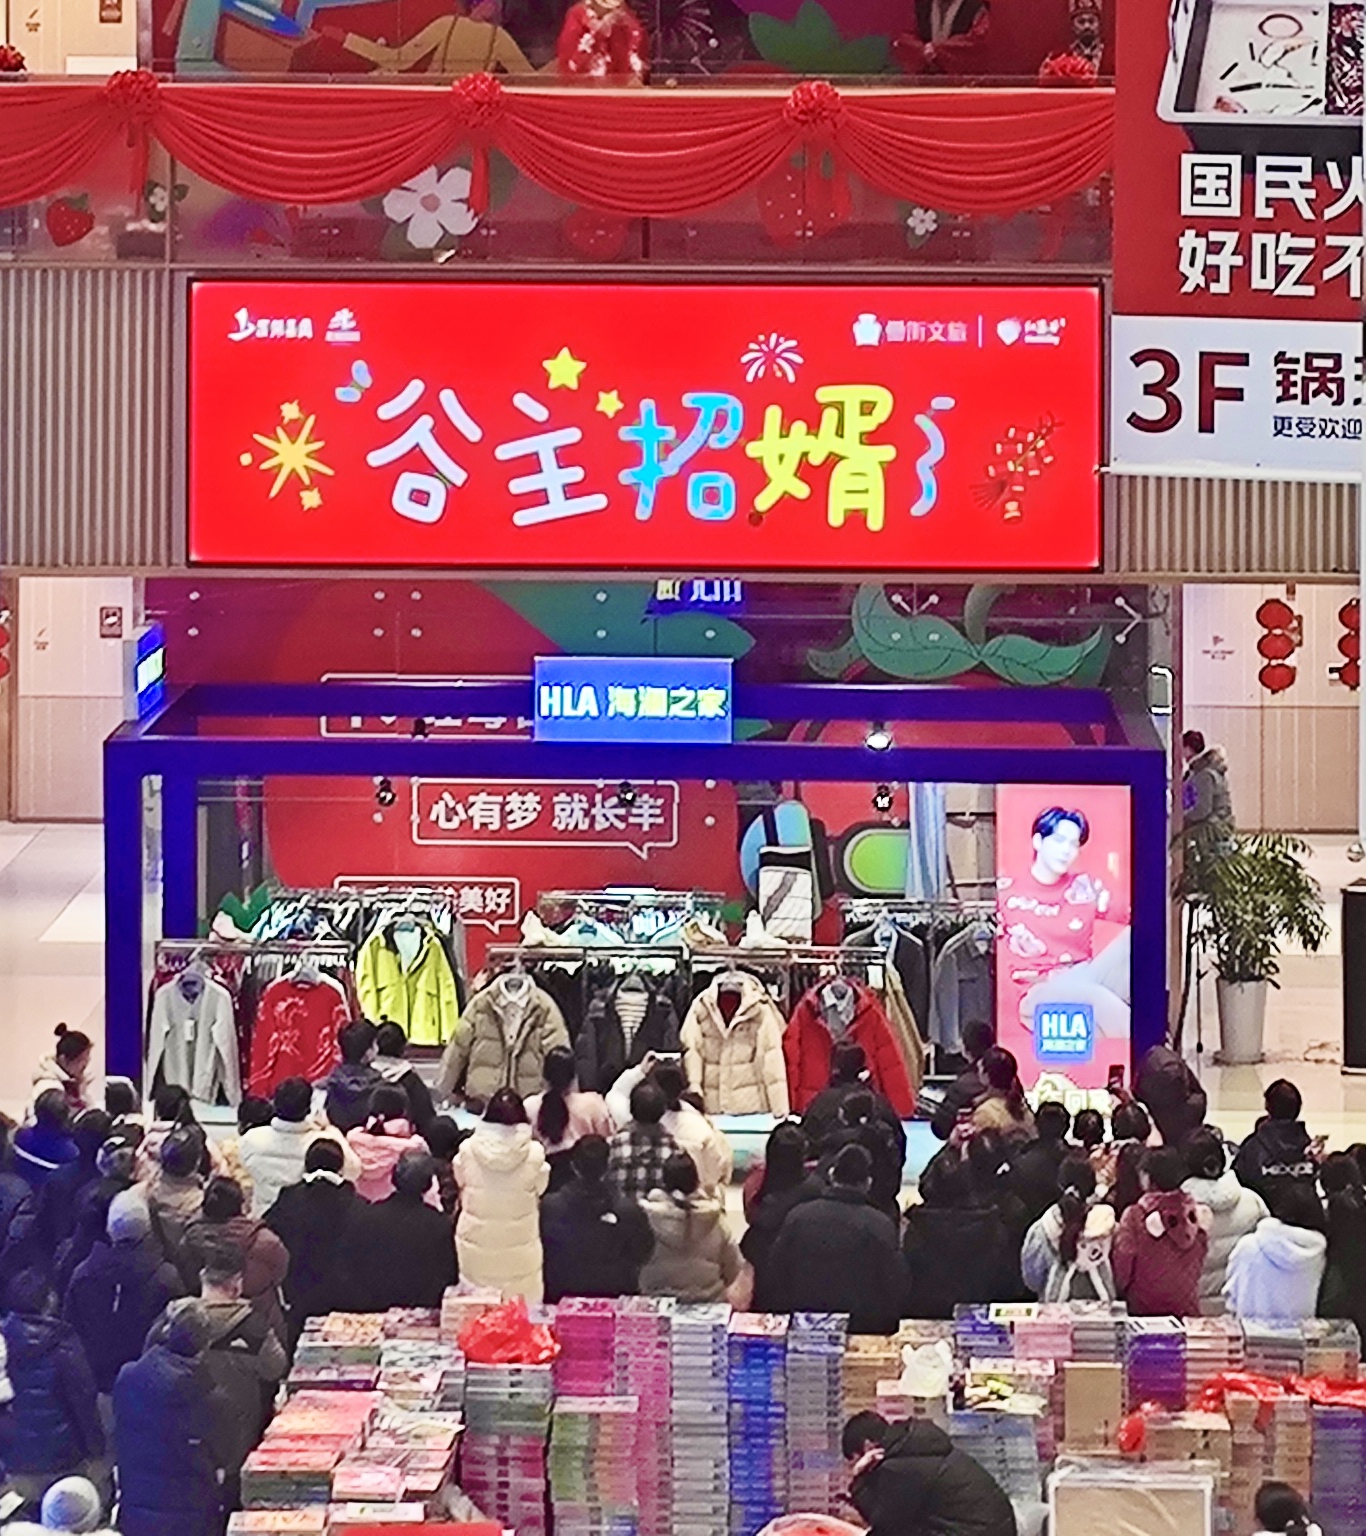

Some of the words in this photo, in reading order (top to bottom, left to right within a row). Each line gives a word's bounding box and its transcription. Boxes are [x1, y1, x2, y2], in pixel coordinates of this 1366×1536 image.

[1126, 348, 1250, 434] 3F
[539, 685, 600, 719] HLA
[429, 791, 542, 831] 心有梦
[1041, 1013, 1087, 1039] HLA
